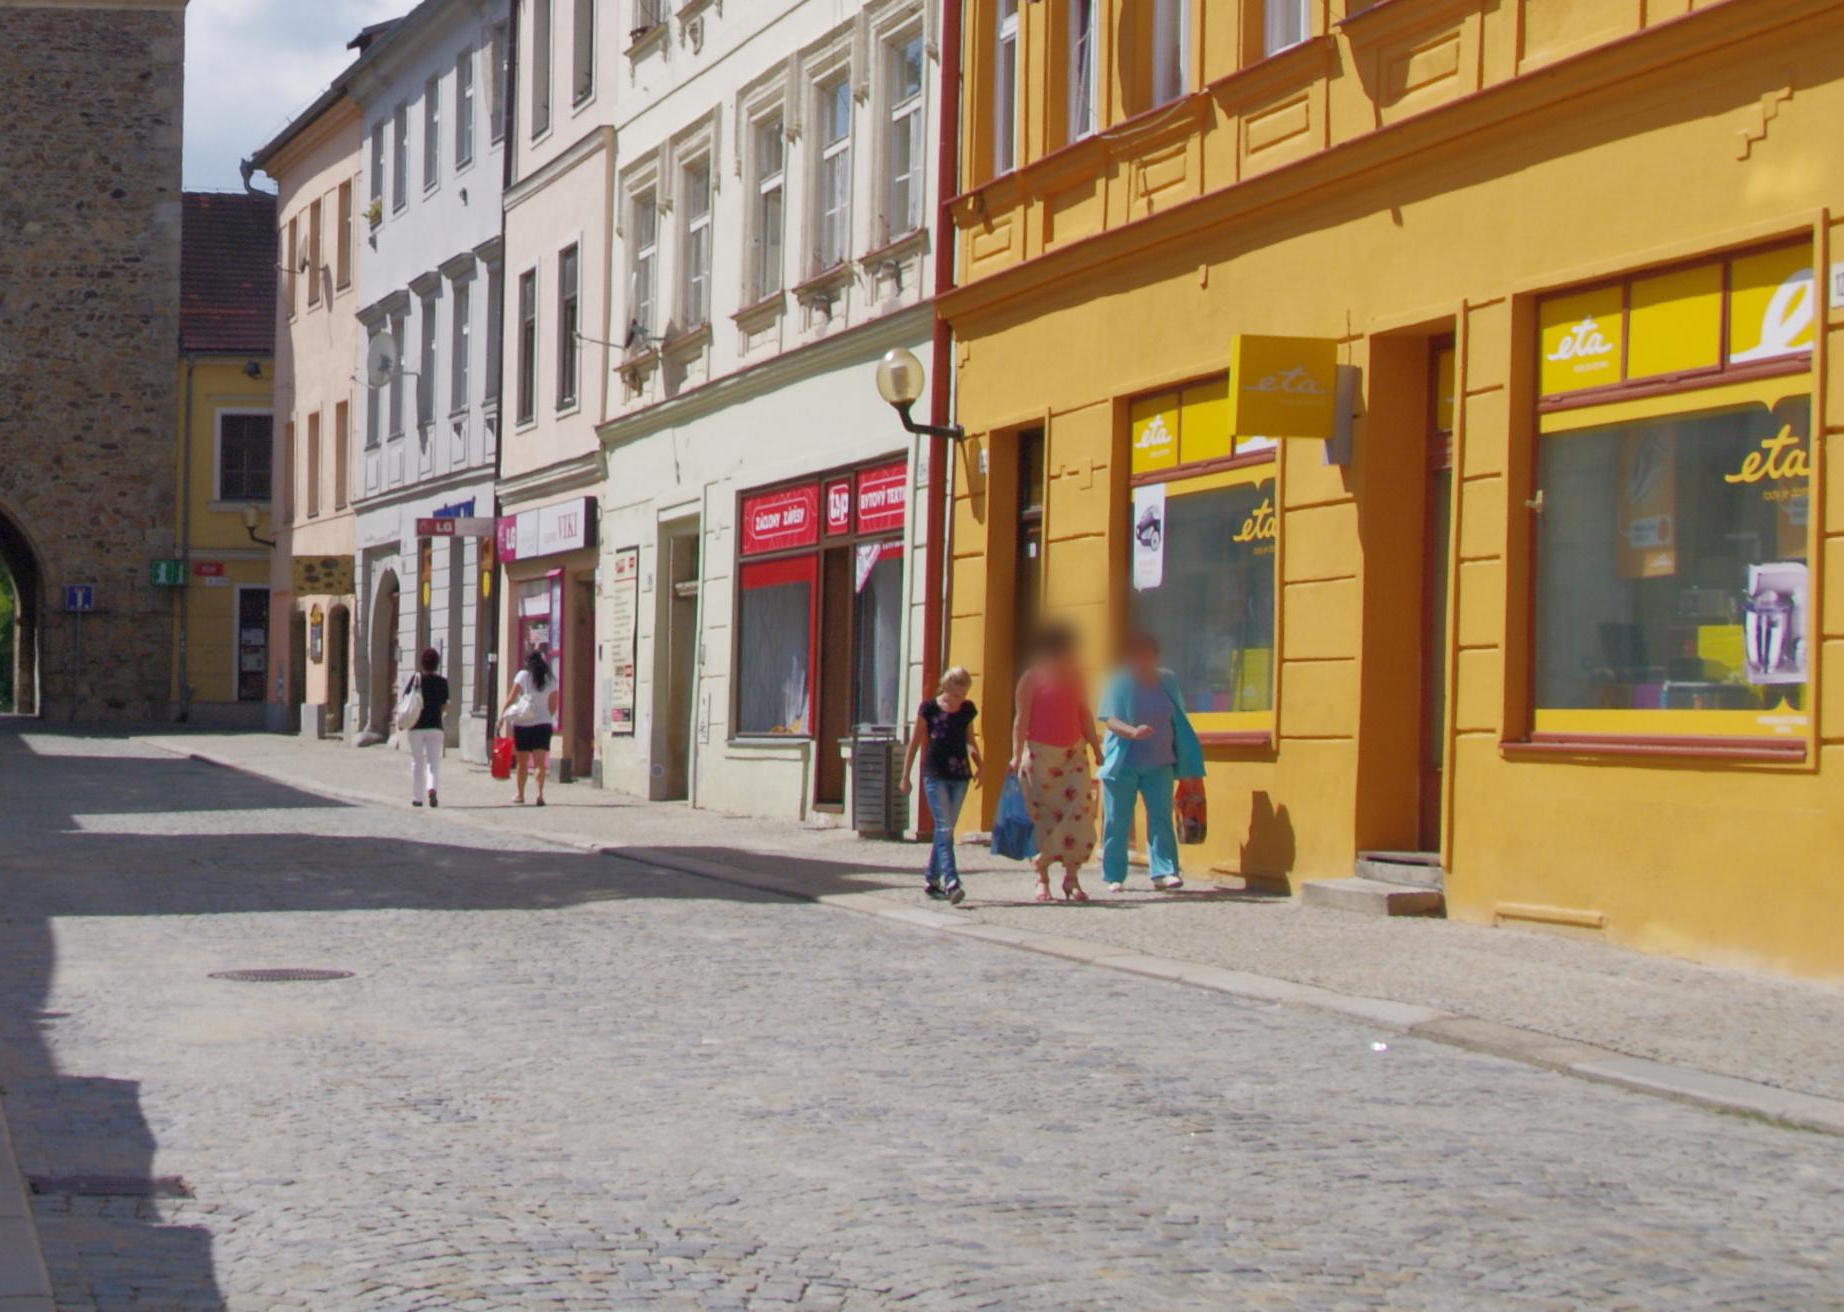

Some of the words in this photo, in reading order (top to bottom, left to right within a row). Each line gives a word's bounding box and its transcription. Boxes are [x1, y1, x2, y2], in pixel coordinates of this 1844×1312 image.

[1547, 315, 1613, 360] eta
[1243, 366, 1326, 394] eta
[1135, 414, 1172, 448] eta
[1724, 423, 1811, 483] eta
[435, 521, 453, 533] LG
[557, 511, 578, 540] VIKI
